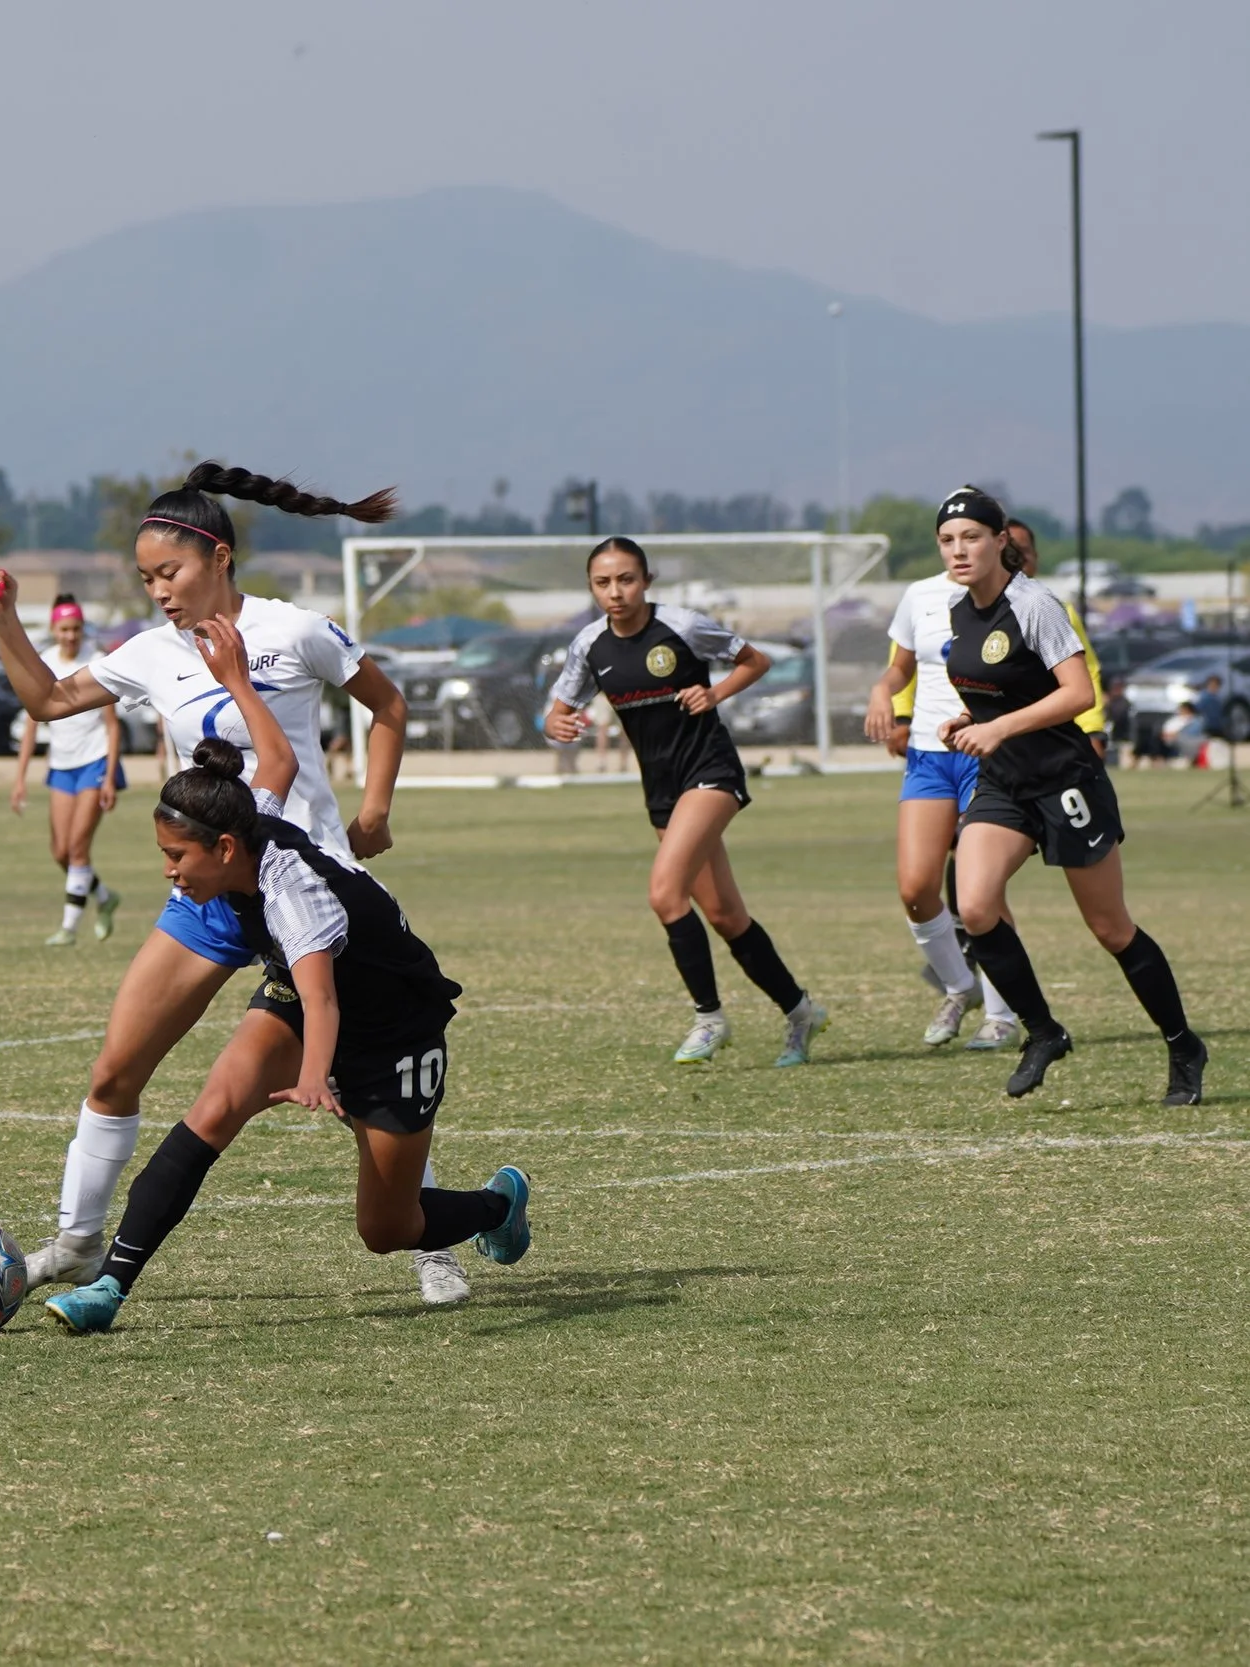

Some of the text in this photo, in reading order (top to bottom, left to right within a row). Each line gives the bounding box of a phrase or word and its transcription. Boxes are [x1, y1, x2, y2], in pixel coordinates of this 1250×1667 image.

[249, 654, 280, 672] URF
[1060, 787, 1091, 829] 9
[395, 1048, 444, 1099] 10
